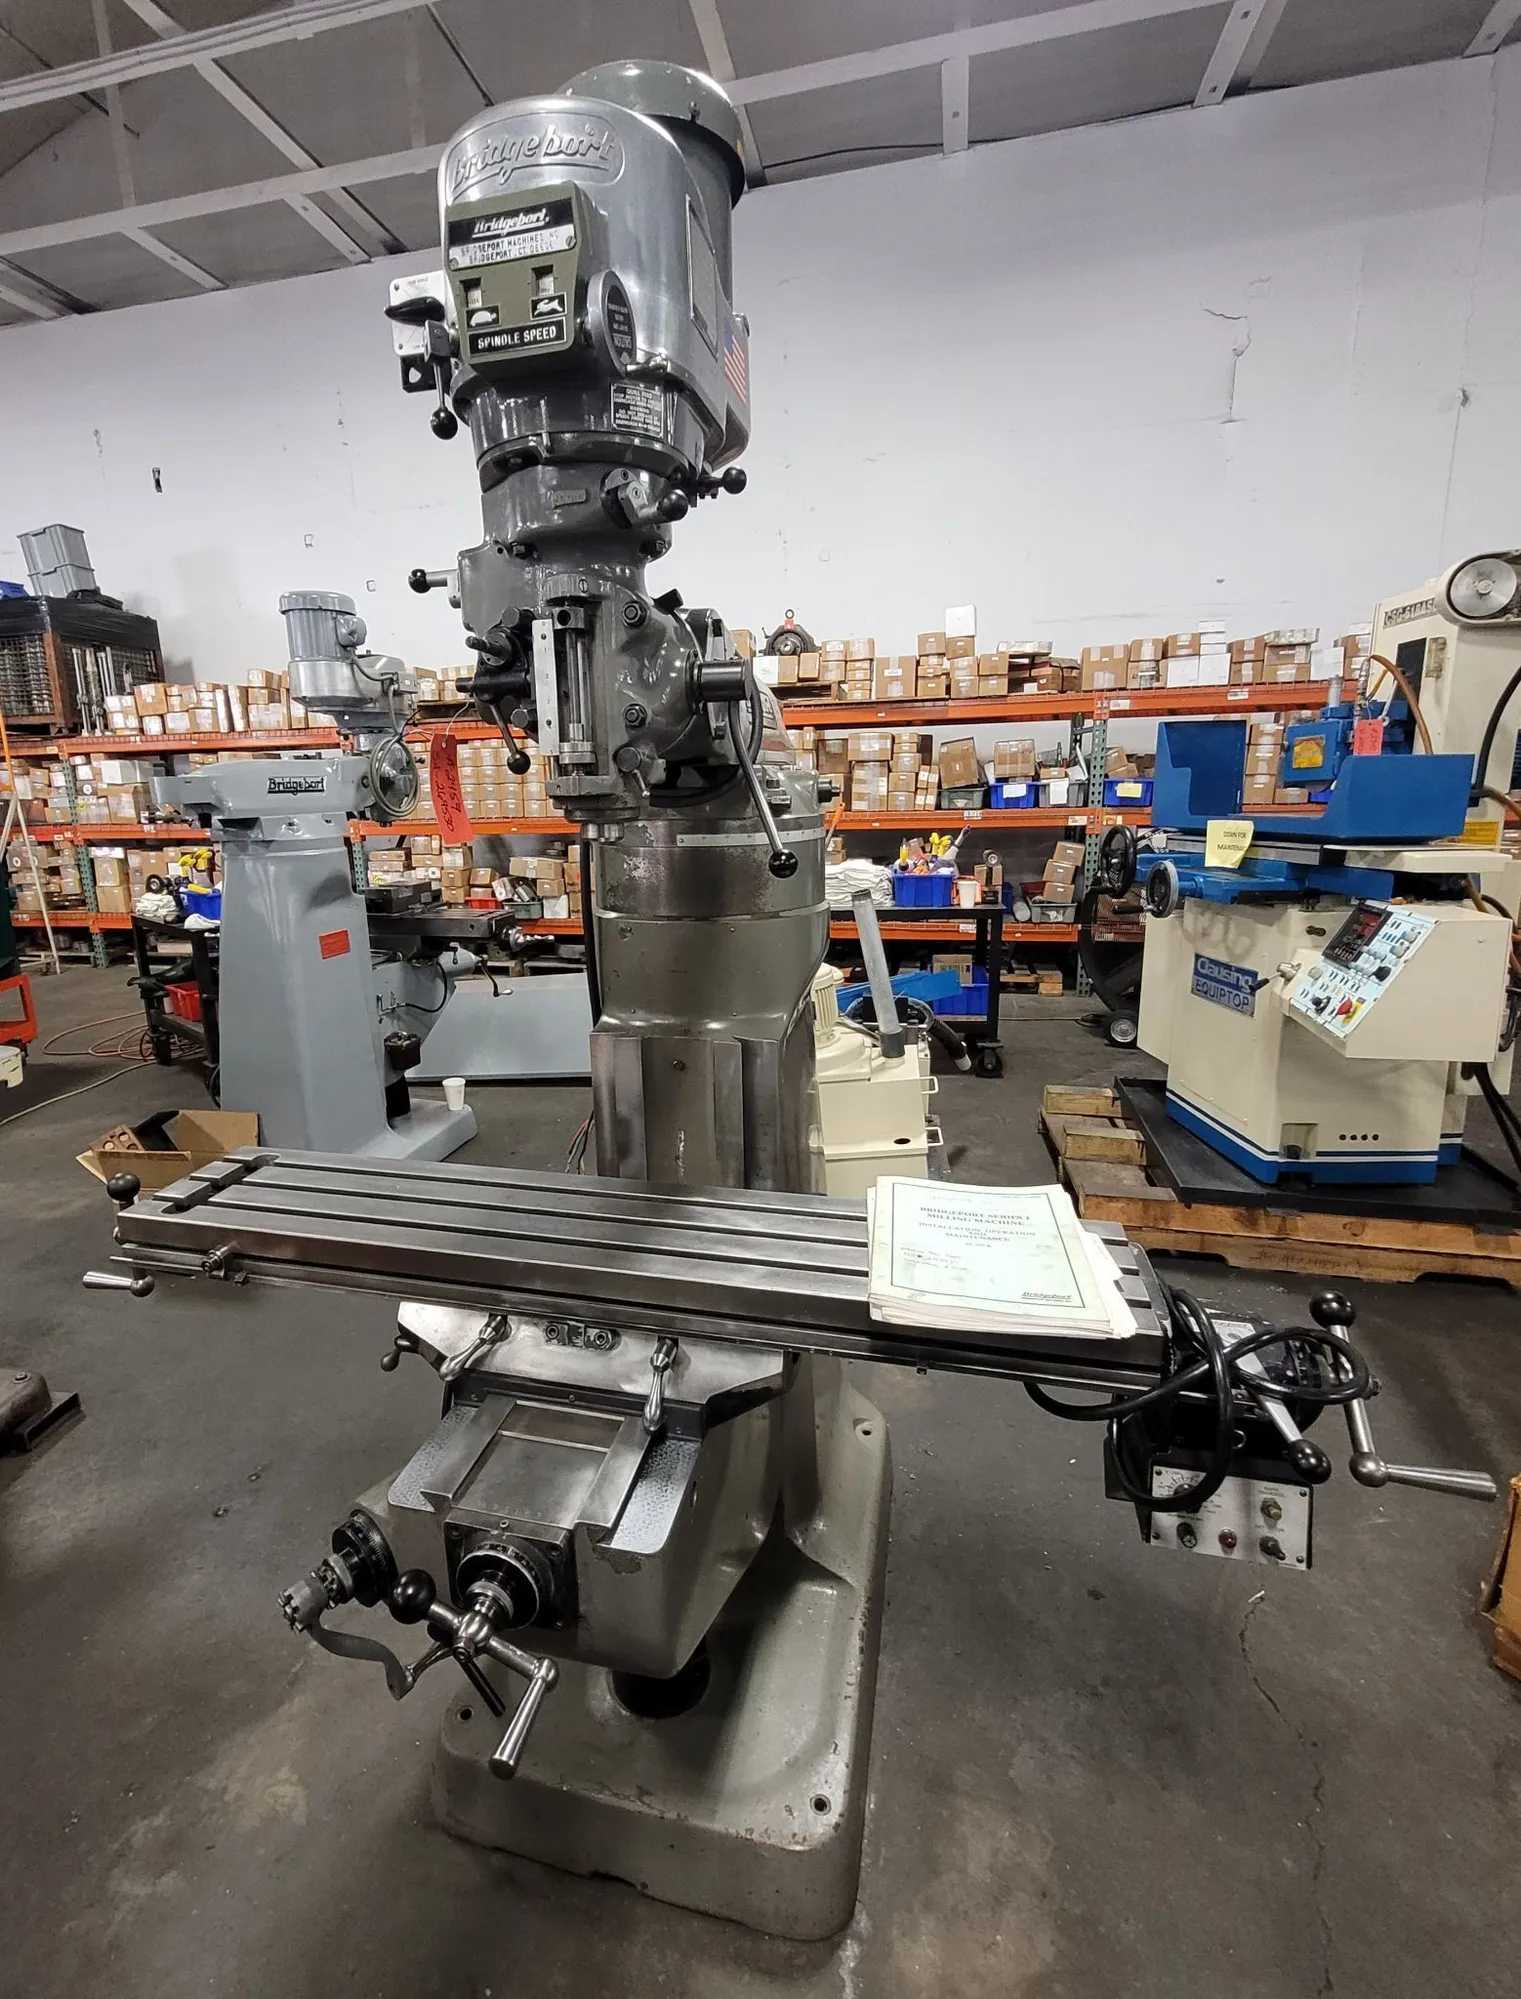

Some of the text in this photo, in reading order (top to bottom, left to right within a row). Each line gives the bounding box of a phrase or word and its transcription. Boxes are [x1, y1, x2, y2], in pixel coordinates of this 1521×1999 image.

[451, 124, 613, 193] Bridgeport
[472, 207, 549, 237] Bridgeport
[478, 325, 557, 350] SPINDLE SPEED
[268, 776, 325, 796] Bridgeport
[1197, 957, 1253, 993] Clausing
[1195, 979, 1250, 1010] EQUIPTOP
